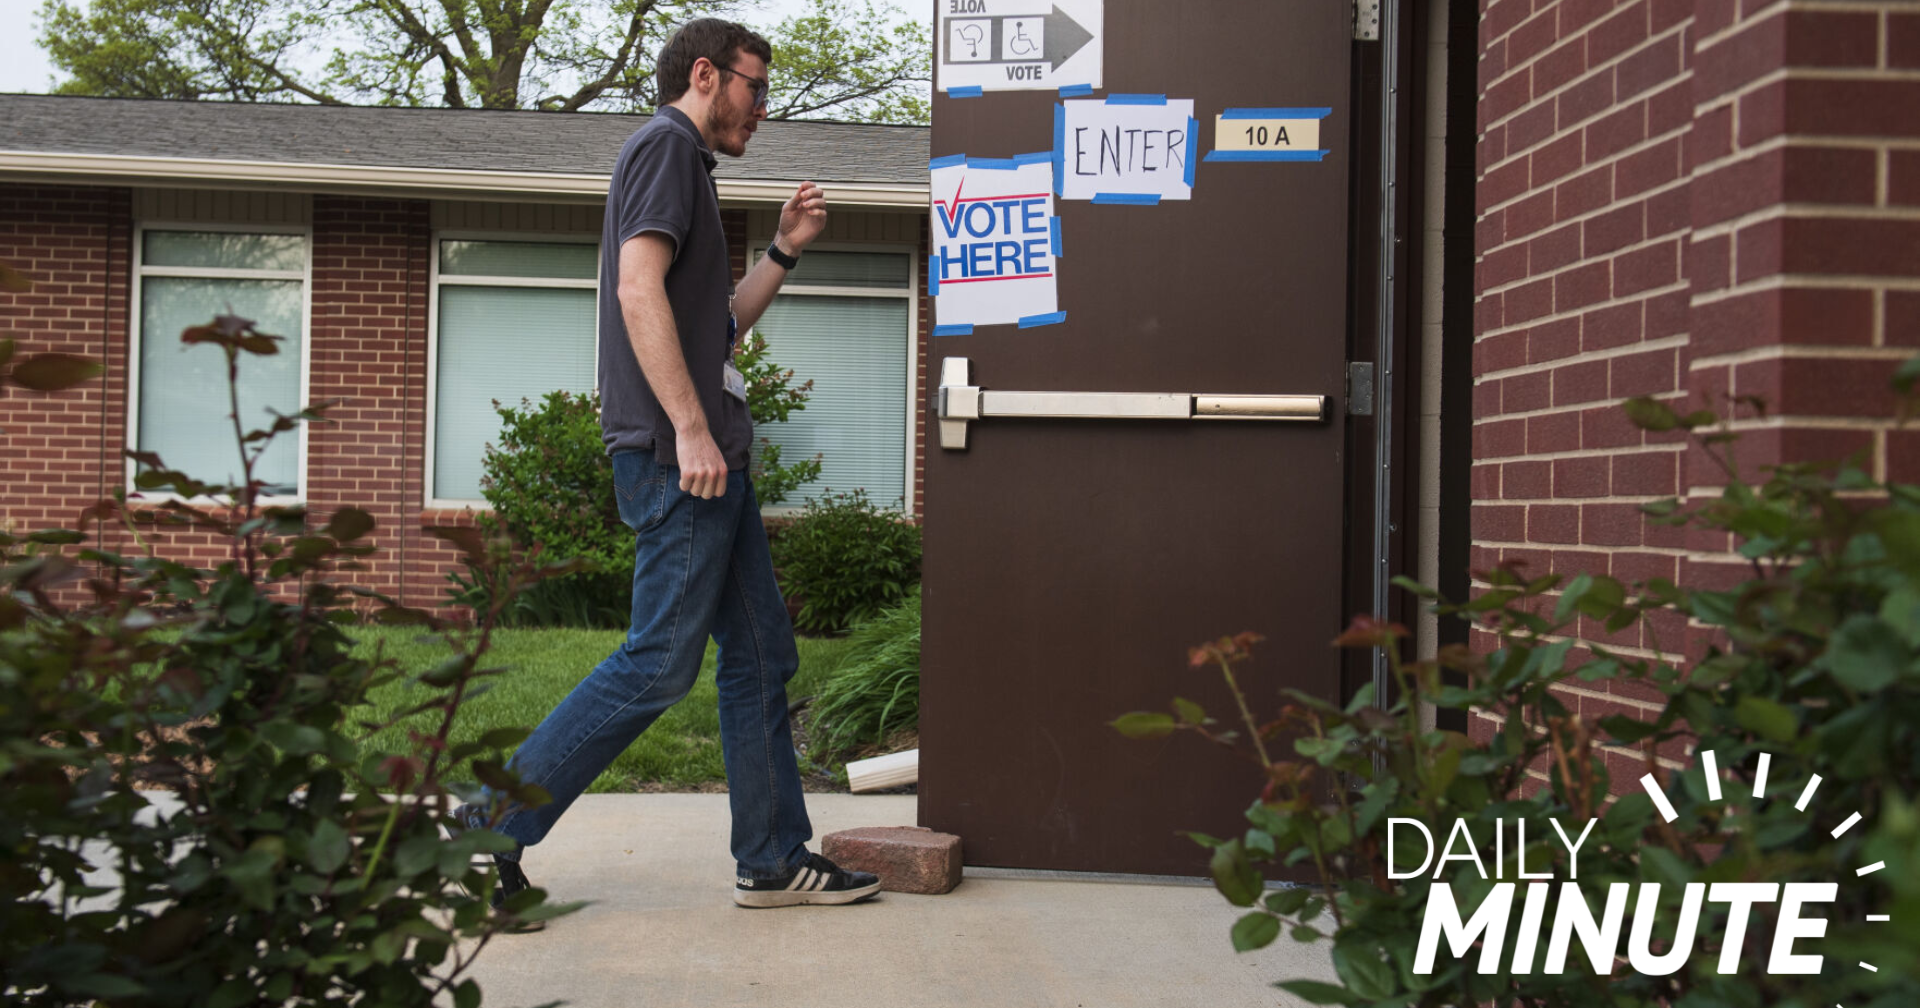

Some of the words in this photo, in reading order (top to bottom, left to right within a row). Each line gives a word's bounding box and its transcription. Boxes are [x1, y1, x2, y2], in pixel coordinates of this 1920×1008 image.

[950, 0, 986, 14] VOTE
[1006, 65, 1042, 81] VOTE
[1075, 125, 1185, 177] ENTER
[1245, 126, 1268, 146] 10
[1275, 126, 1290, 146] A
[936, 198, 1048, 239] VOTE
[940, 238, 1050, 279] HERE
